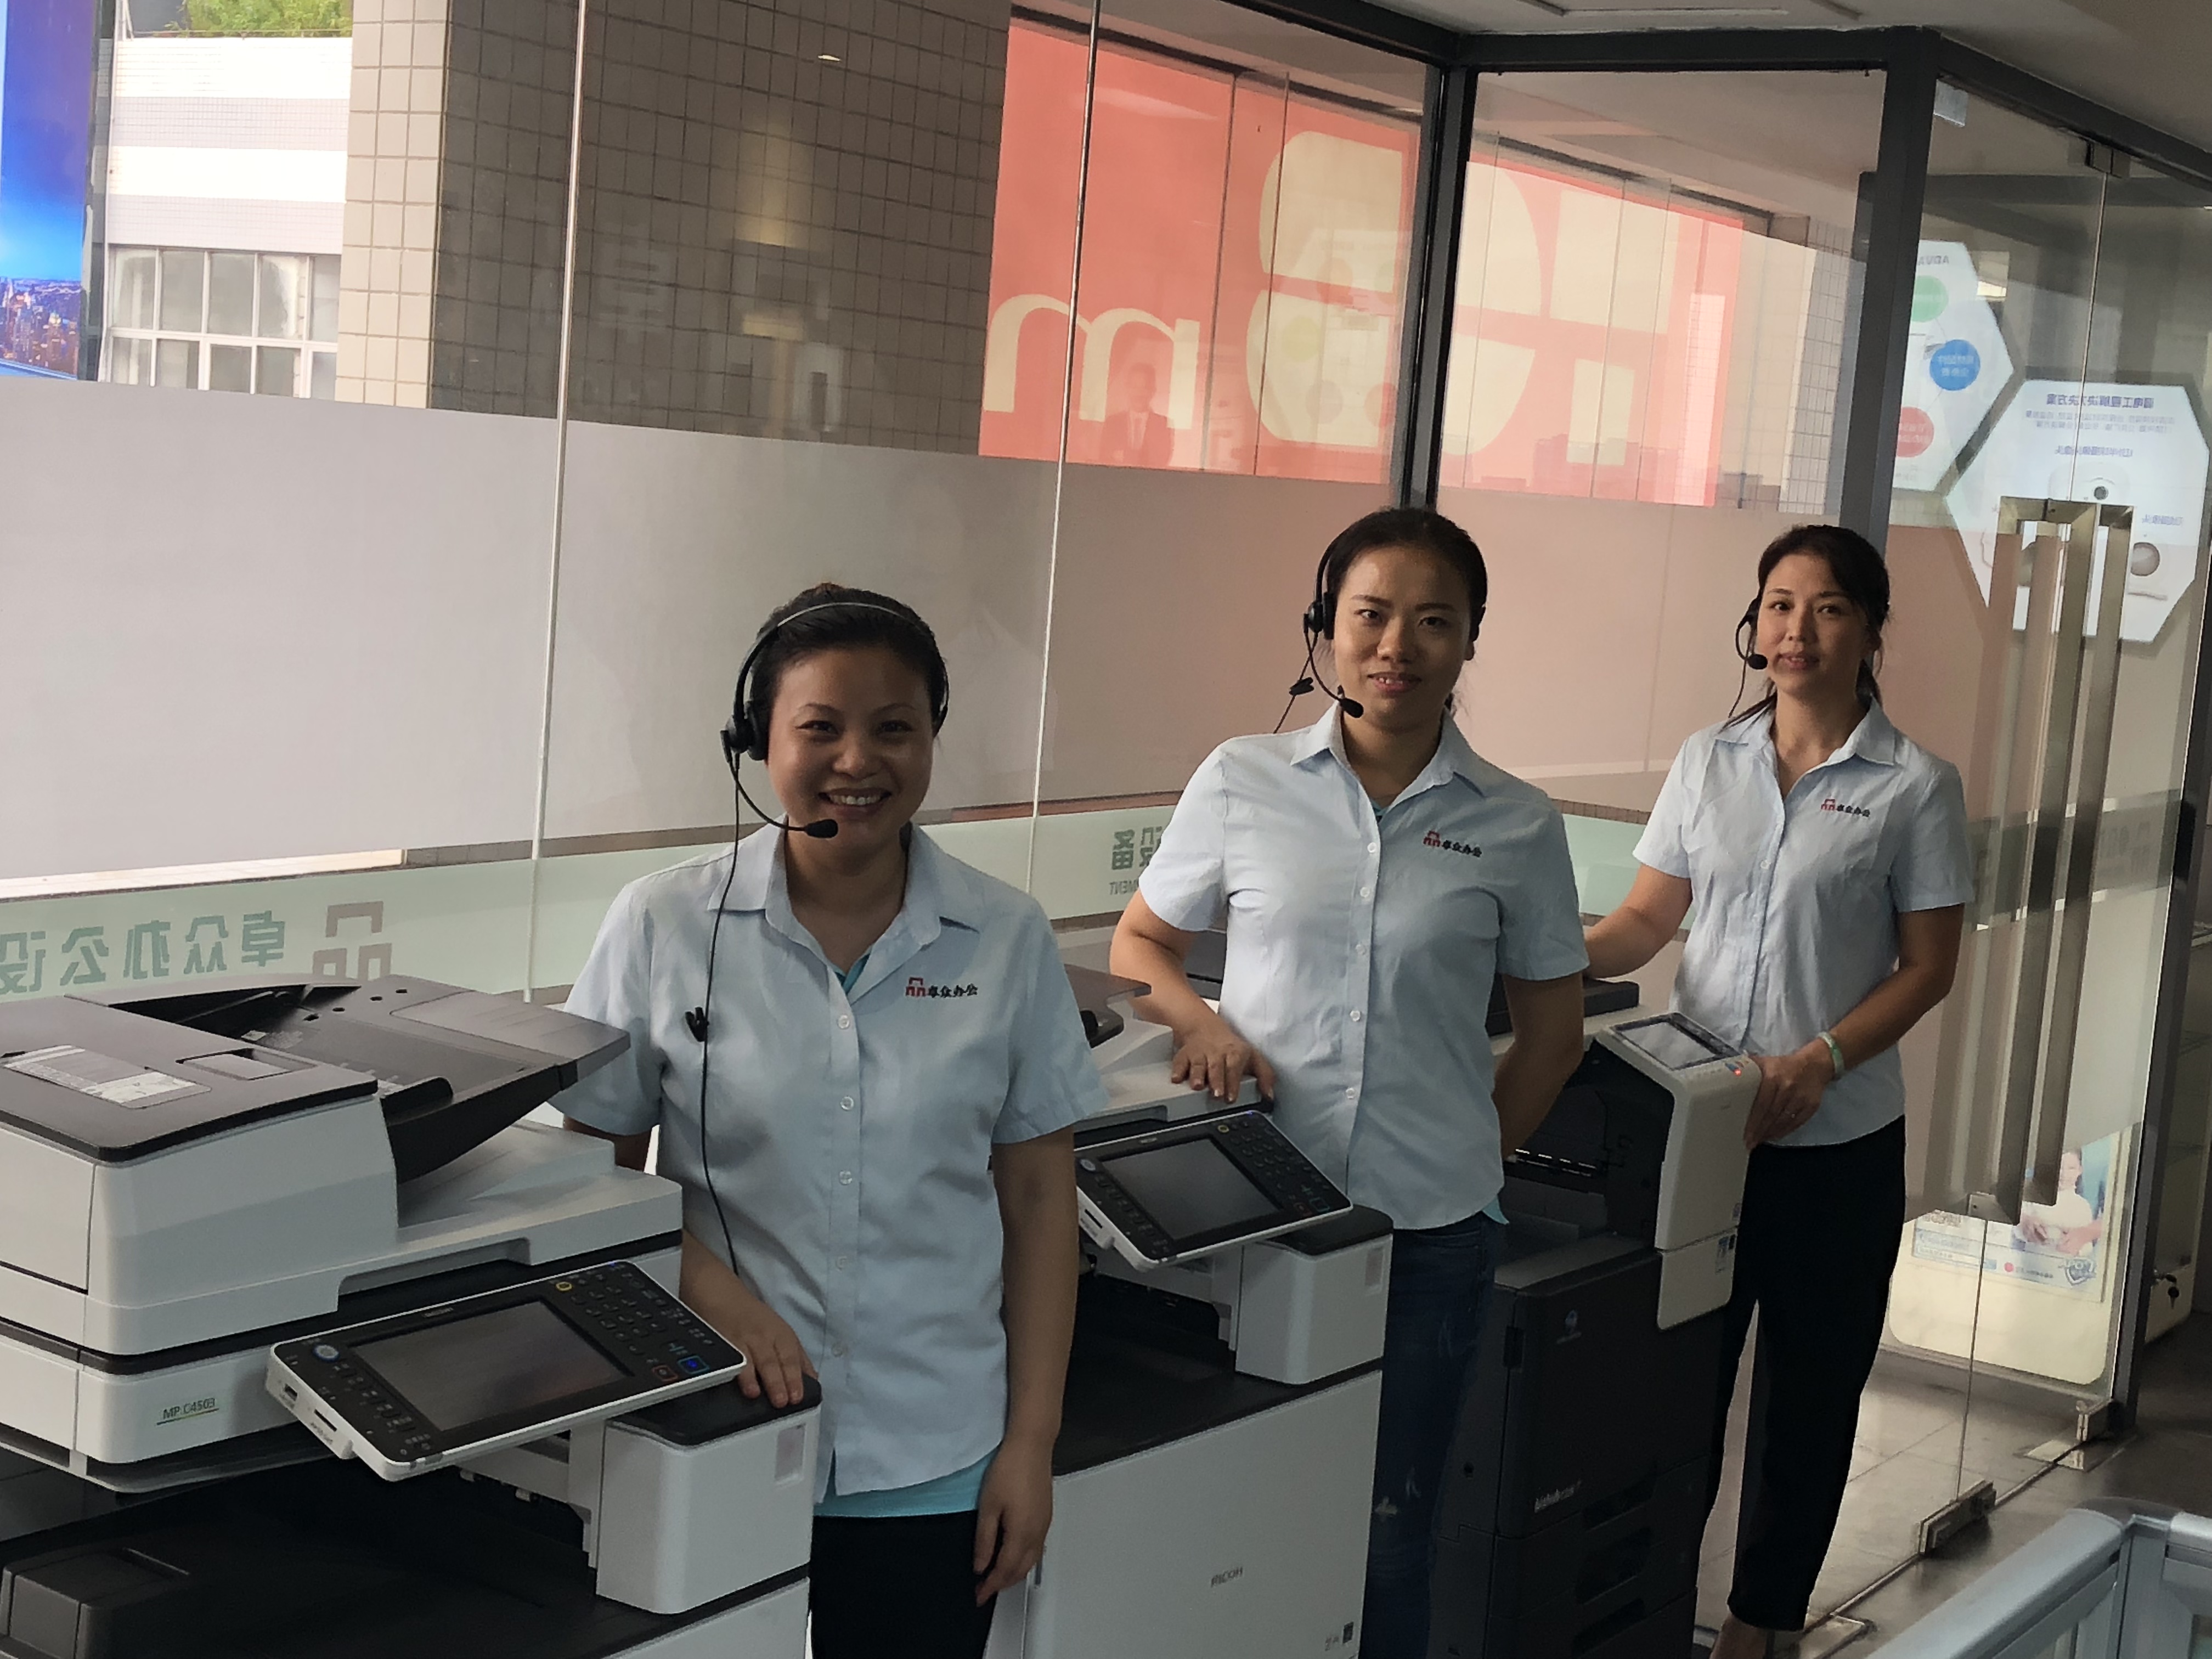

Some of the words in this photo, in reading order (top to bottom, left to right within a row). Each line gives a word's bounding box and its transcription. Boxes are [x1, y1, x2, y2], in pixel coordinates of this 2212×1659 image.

[928, 983, 978, 998] 卓众办公
[163, 1406, 180, 1420] MP
[1211, 1566, 1243, 1588] RICOH
